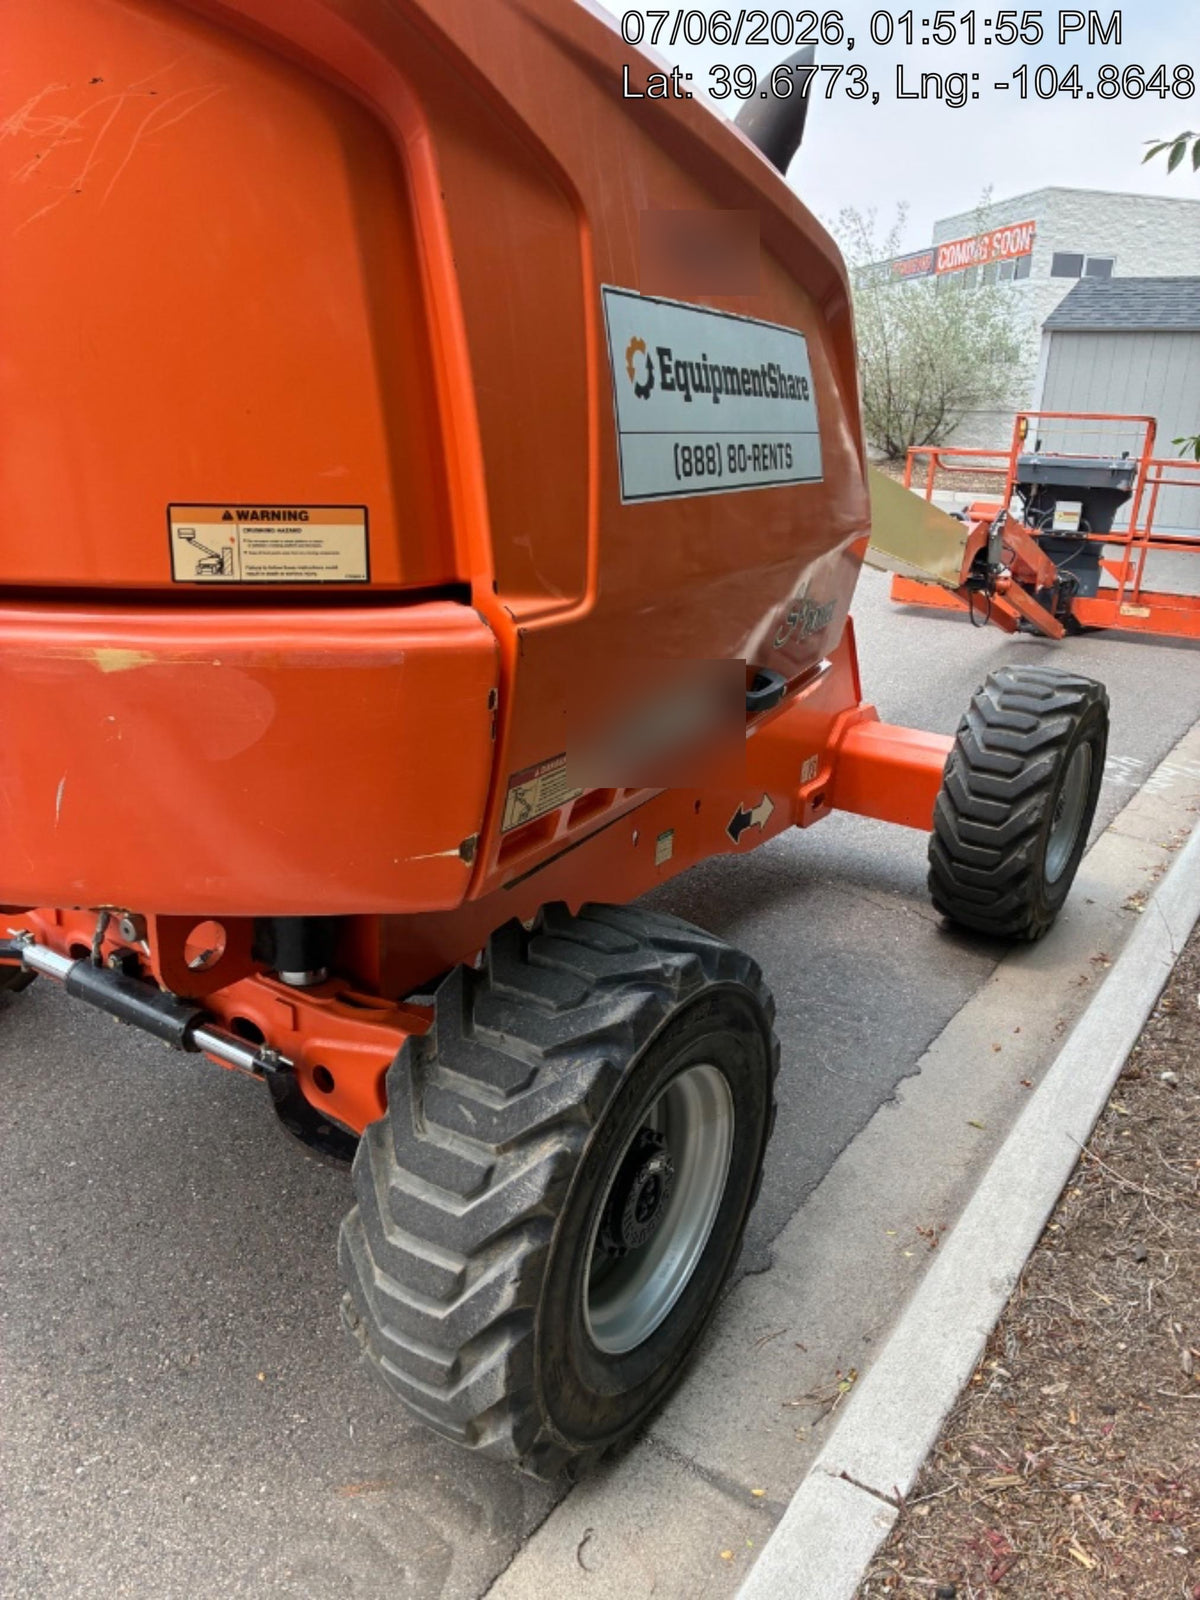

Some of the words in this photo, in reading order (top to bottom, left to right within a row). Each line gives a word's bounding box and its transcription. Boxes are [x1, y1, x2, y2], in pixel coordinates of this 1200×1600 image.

[992, 226, 1034, 255] SOON
[657, 347, 809, 404] EquipmentShare
[673, 442, 723, 480] (888)
[727, 442, 793, 473] 80-RENTS
[236, 510, 309, 522] WARNING
